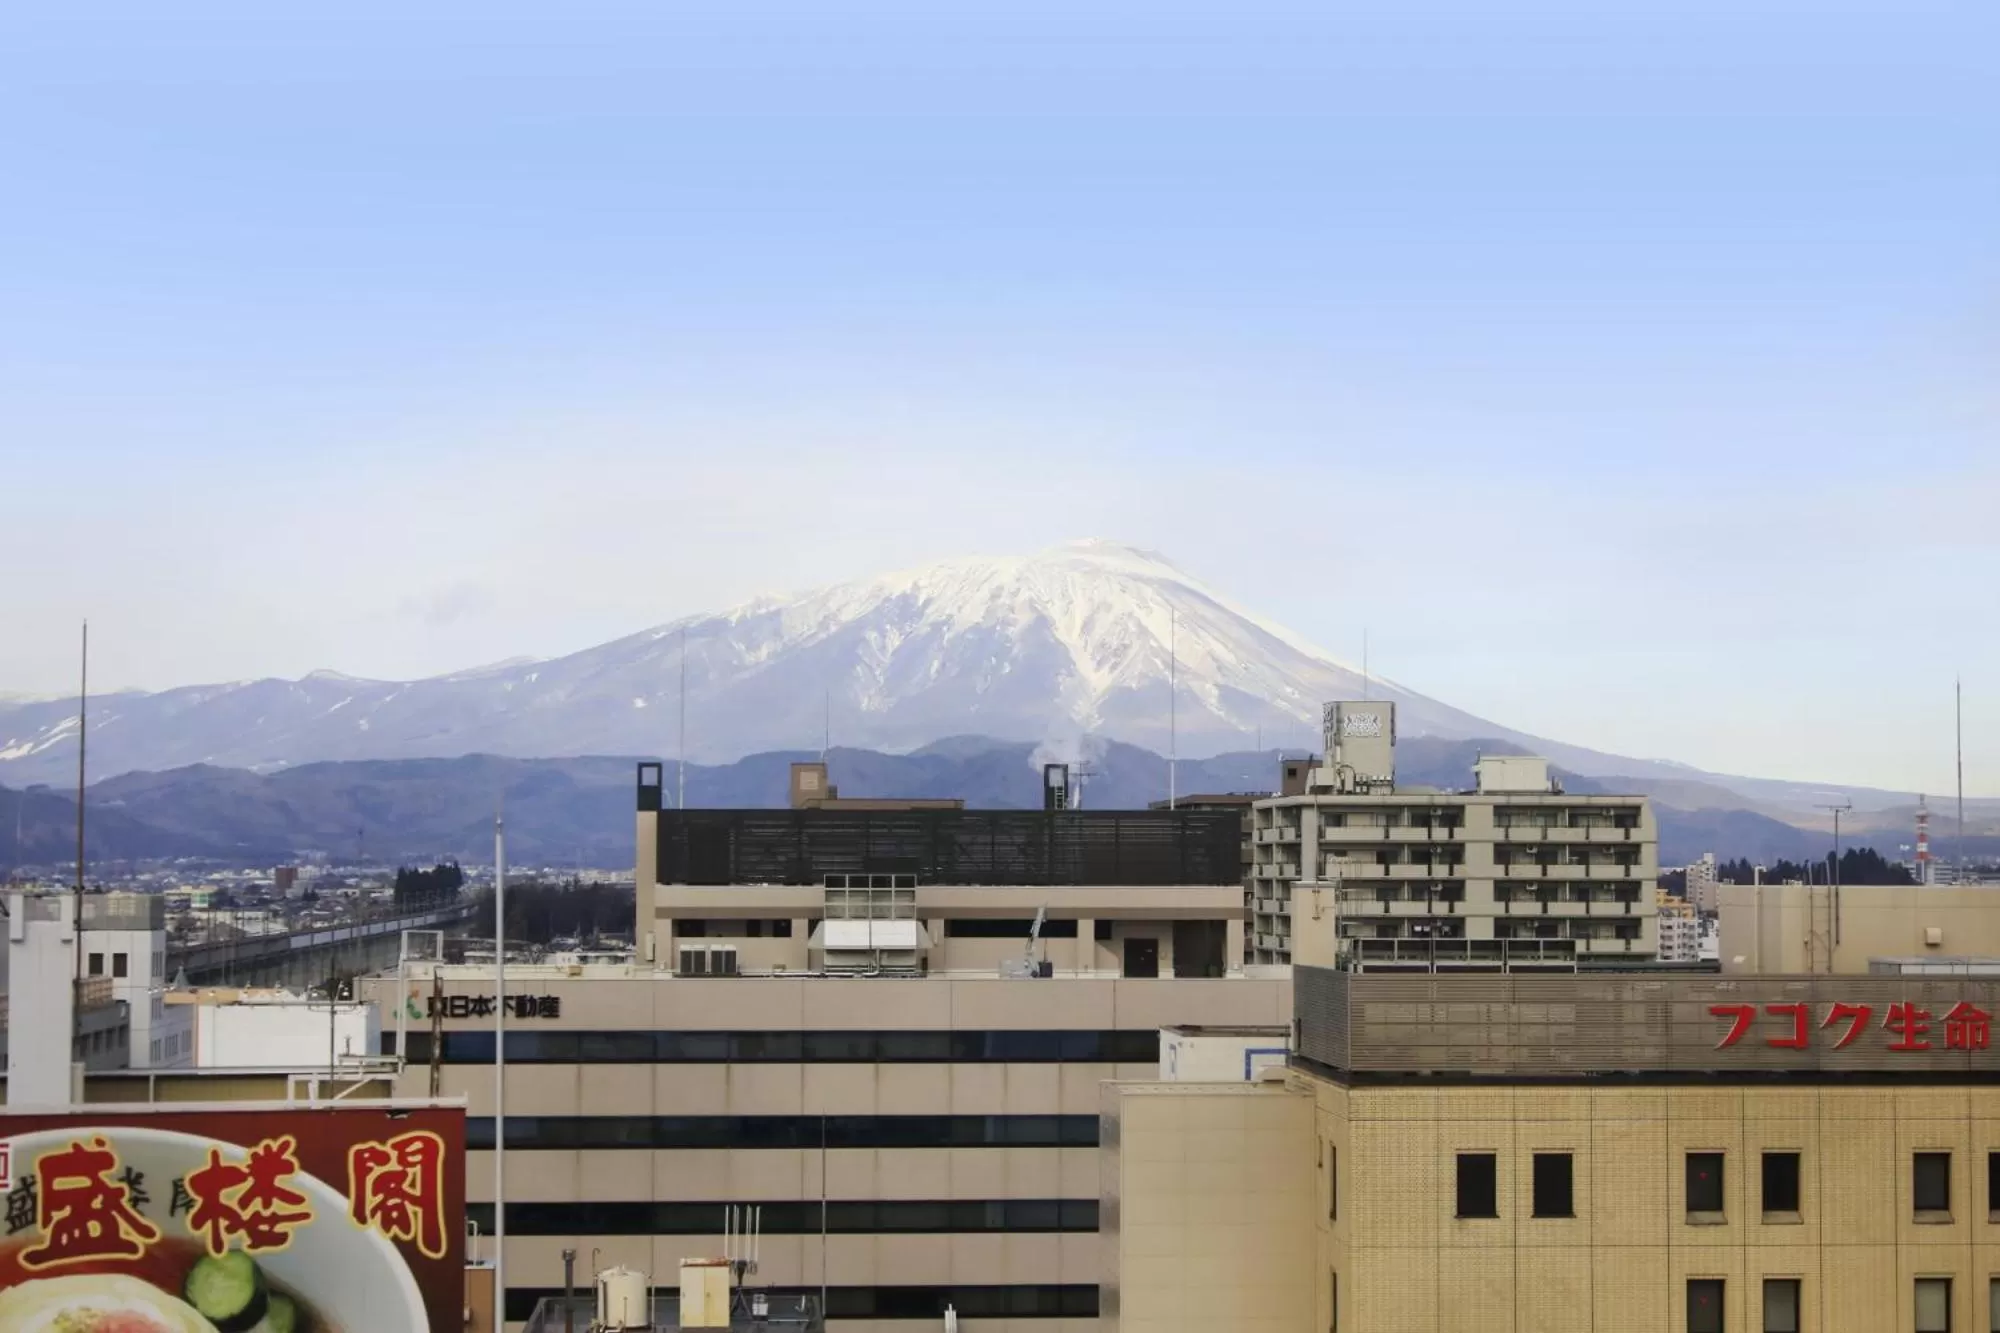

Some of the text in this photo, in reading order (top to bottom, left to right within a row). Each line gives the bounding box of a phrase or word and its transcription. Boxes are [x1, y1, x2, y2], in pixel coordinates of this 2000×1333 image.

[1708, 1002, 1993, 1050] フコク生命
